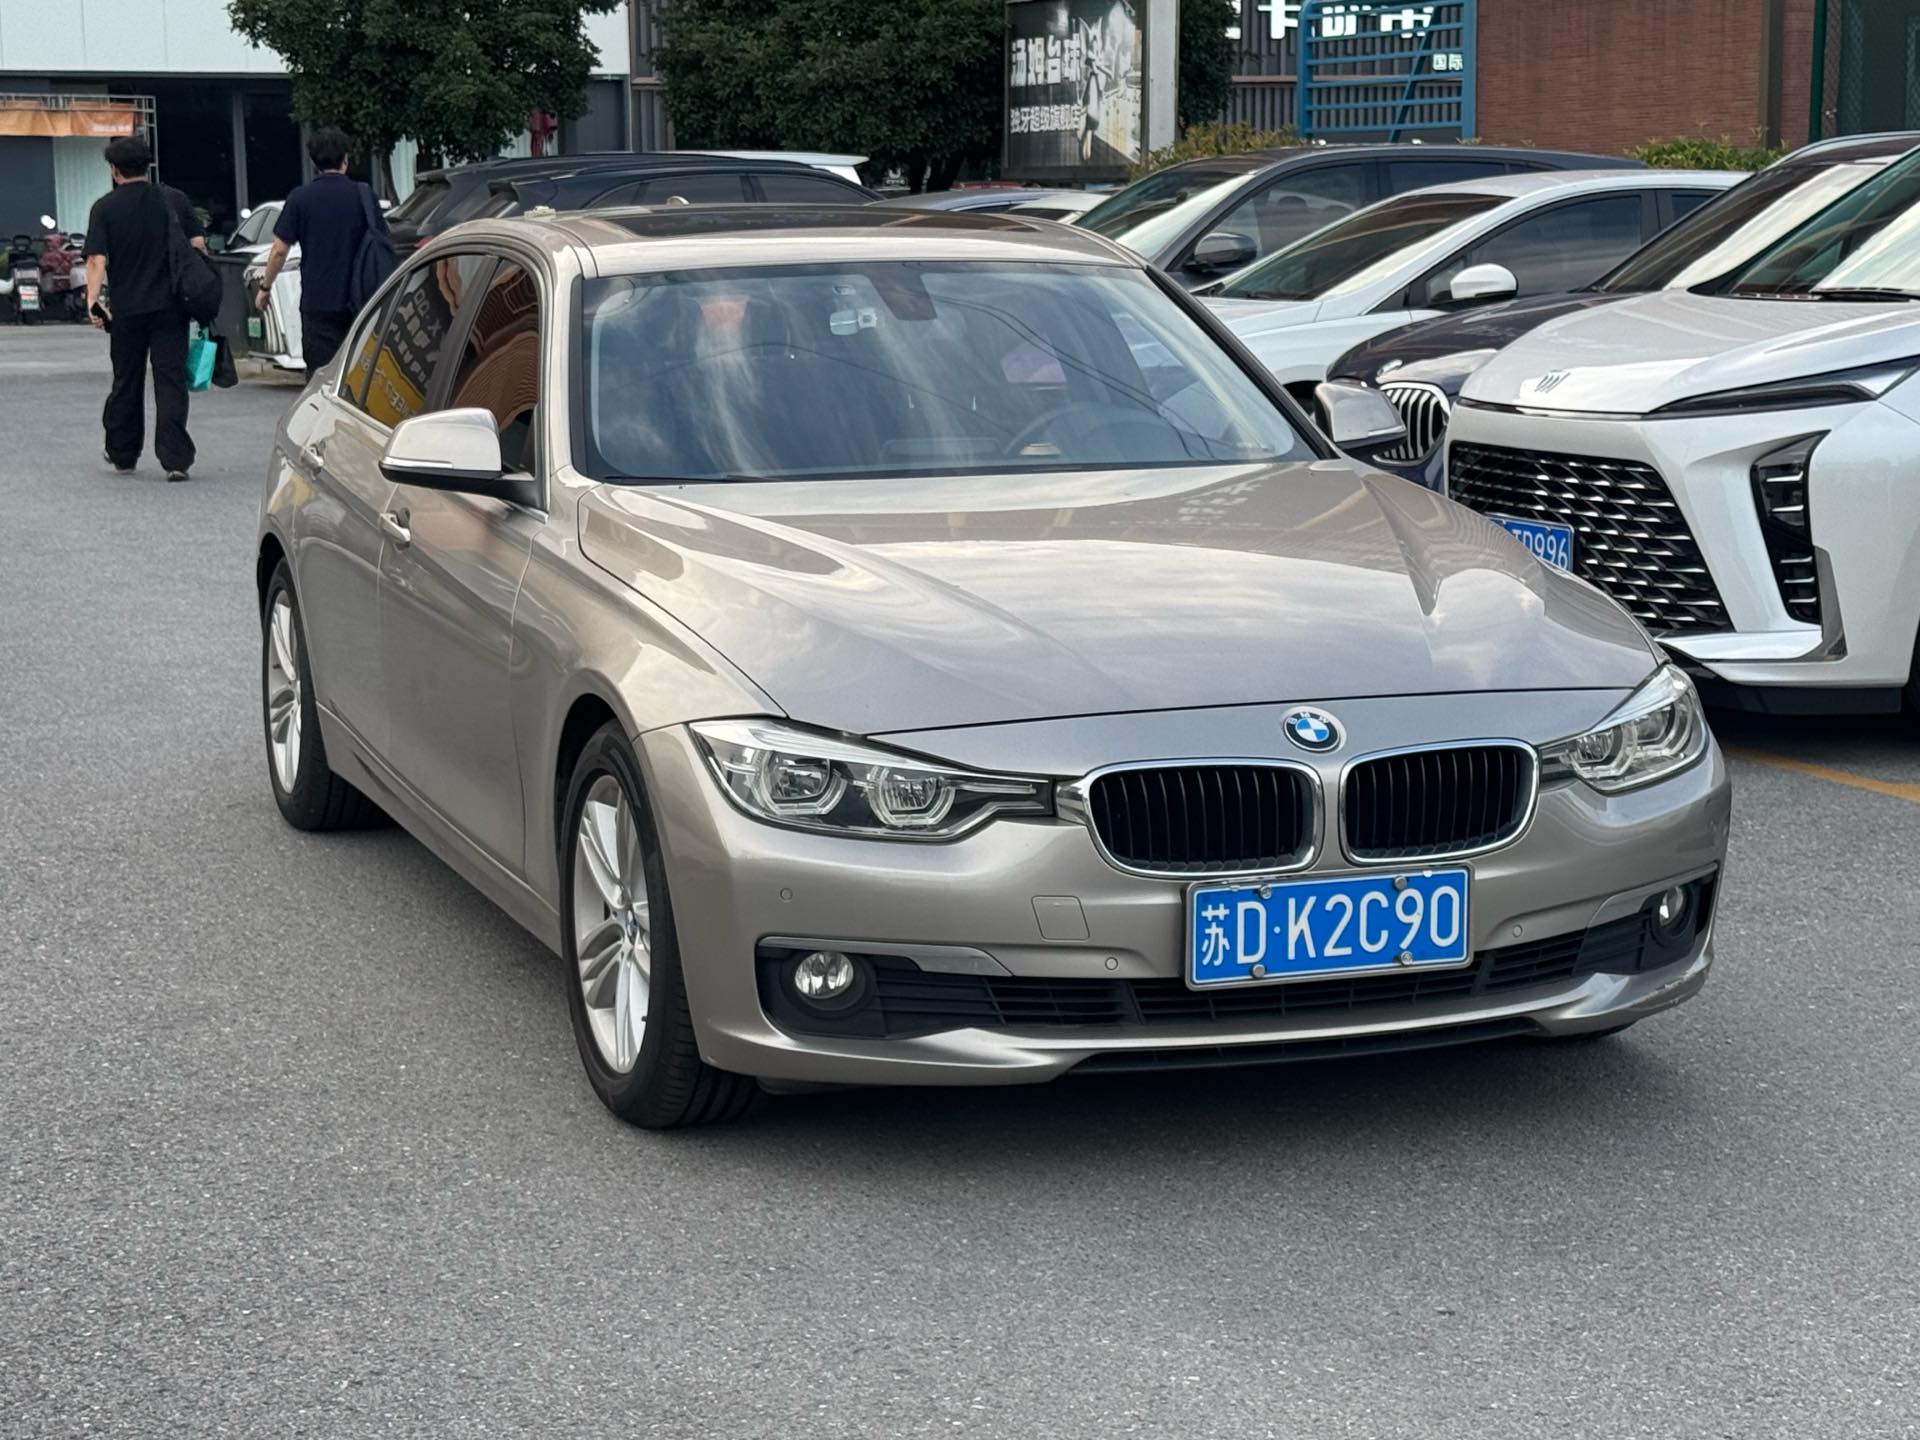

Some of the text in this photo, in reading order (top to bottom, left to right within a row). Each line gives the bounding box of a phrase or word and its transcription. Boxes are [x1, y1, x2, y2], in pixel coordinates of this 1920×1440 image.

[1010, 33, 1080, 87] 汤姆台球
[1433, 53, 1463, 70] 国际
